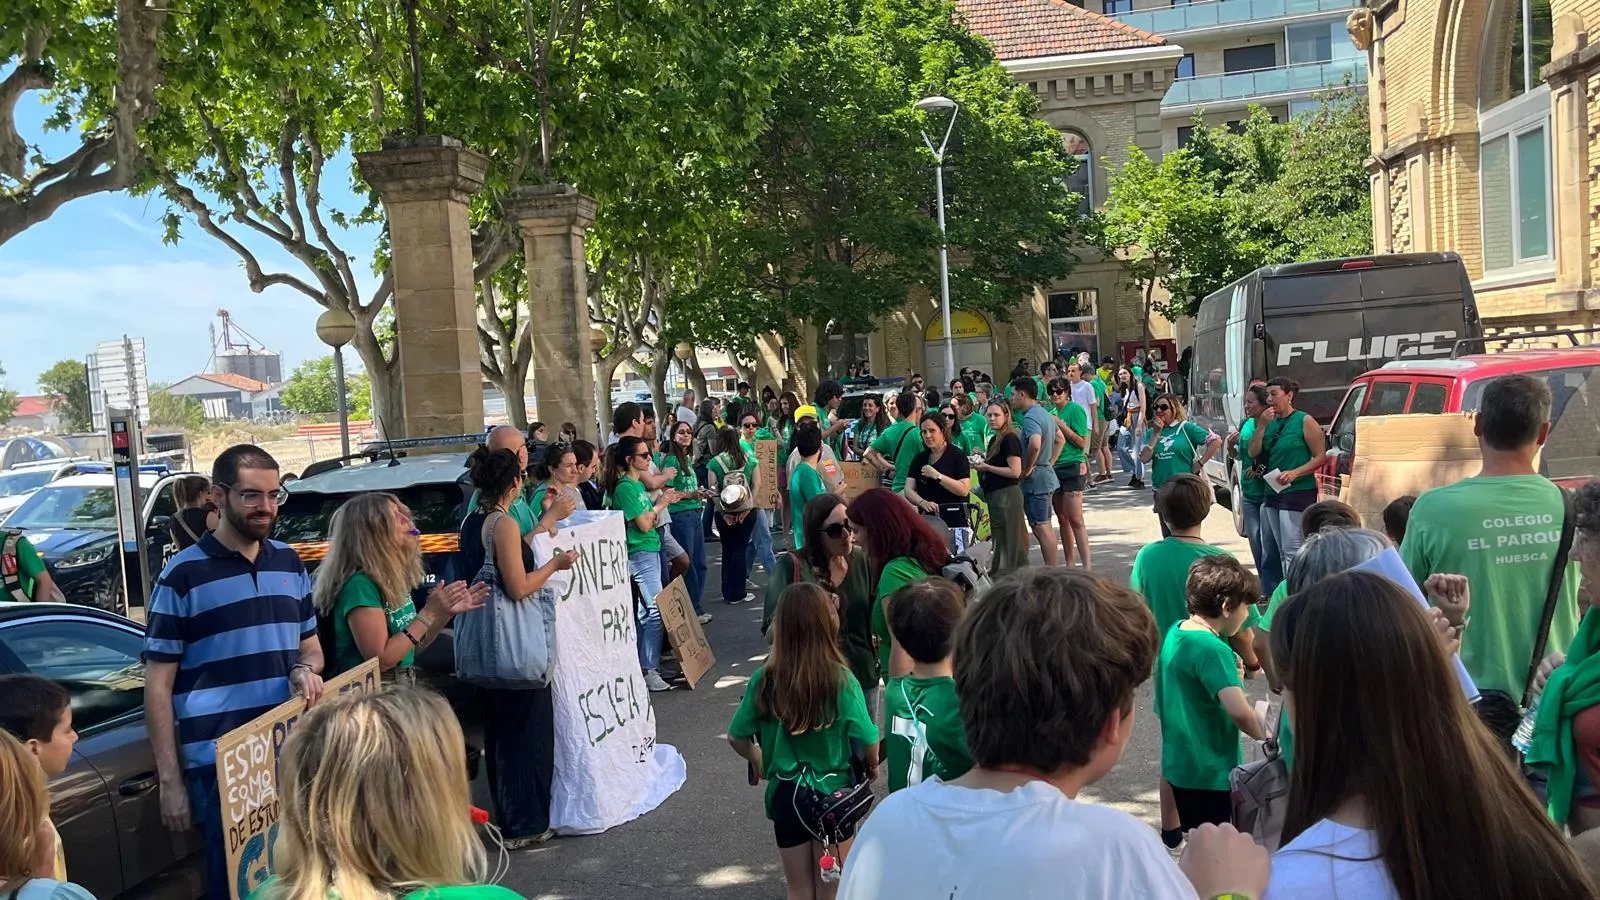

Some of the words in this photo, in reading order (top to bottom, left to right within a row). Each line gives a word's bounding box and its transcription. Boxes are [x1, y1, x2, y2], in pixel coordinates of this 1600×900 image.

[1482, 514, 1553, 529] COLEGIO
[1467, 538, 1491, 550] EL
[1497, 531, 1561, 548] PARQU
[1495, 552, 1548, 564] HUESCA
[224, 730, 272, 787] ESTOY
[228, 770, 271, 804] COMO
[231, 785, 275, 823] UNA
[229, 819, 246, 855] DE
[249, 800, 281, 835] ESTUD
